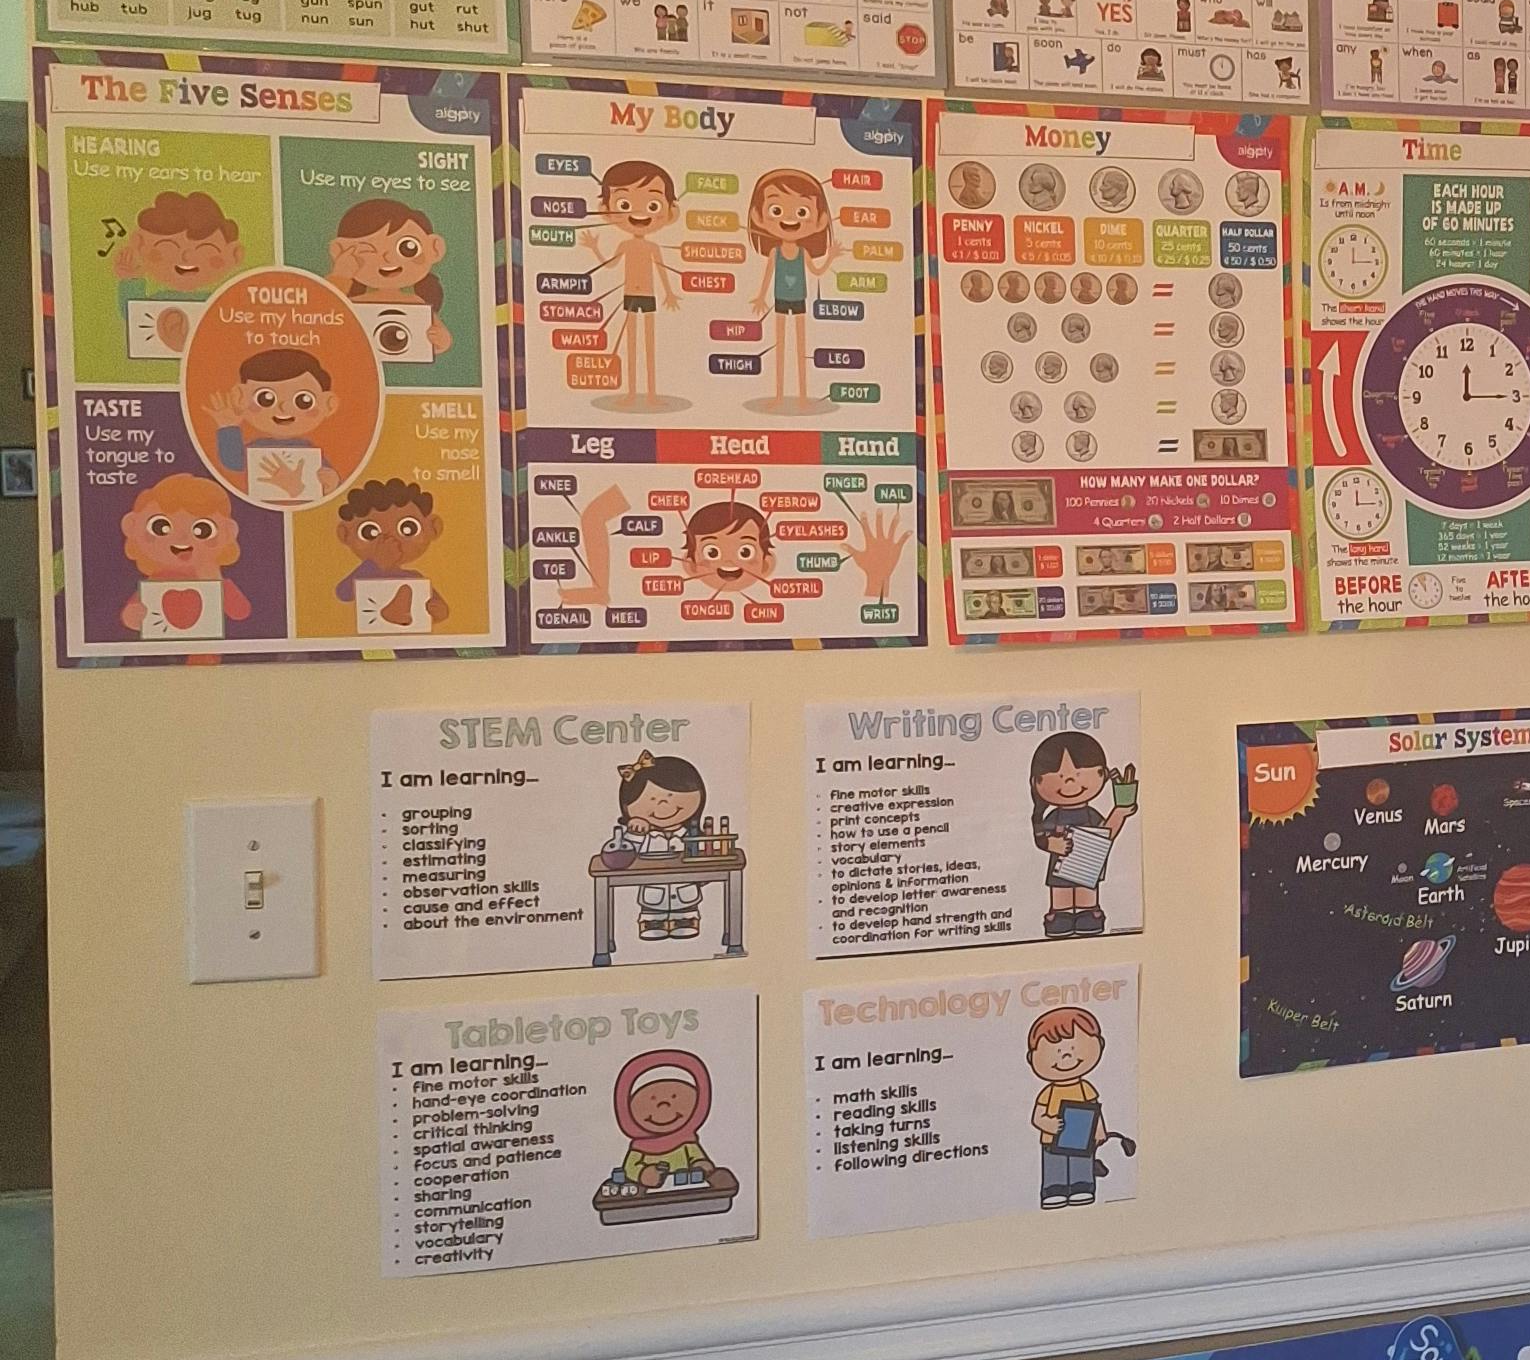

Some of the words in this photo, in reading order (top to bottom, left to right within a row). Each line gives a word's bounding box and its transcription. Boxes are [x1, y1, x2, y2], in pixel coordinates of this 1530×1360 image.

[81, 74, 147, 102] The
[159, 77, 229, 106] Five
[240, 83, 353, 112] Senses
[611, 102, 654, 133] My
[665, 105, 735, 137] Body
[72, 136, 160, 157] HEARING
[1025, 124, 1111, 156] Money
[1402, 138, 1462, 162] Time
[418, 151, 469, 170] SIGHT
[548, 158, 579, 171] EYES
[300, 170, 336, 188] Use
[339, 173, 367, 191] my
[371, 175, 411, 192] eyes
[417, 175, 436, 191] to
[440, 178, 471, 191] see
[952, 219, 993, 232] PENNY
[690, 275, 726, 290] CHEST
[247, 286, 307, 305] TOUCH
[84, 399, 142, 417] TASTE
[421, 402, 477, 420] SMELL
[572, 434, 615, 460] Leg
[710, 436, 770, 456] Head
[838, 436, 900, 456] Hand
[1080, 475, 1105, 488] HOW
[1111, 476, 1145, 488] MANY
[1150, 474, 1183, 487] MAKE
[1186, 474, 1208, 487] ONE
[1211, 474, 1259, 487] DOLLAR?
[1335, 575, 1402, 596] BEFORE
[439, 717, 542, 750] STEM
[554, 713, 689, 744] Center
[849, 709, 982, 741] Writing
[992, 704, 1109, 733] Center
[1389, 730, 1447, 753] Solar
[1254, 763, 1296, 784] Sun
[1354, 807, 1403, 827] Venus
[1424, 817, 1466, 836] Mars
[403, 838, 486, 851] classifying
[1296, 852, 1368, 874] Mercury
[403, 883, 498, 898] observation
[504, 881, 539, 893] skills
[1418, 886, 1465, 905] Earth
[819, 989, 1011, 1026] Technology
[1021, 978, 1128, 1007] Center
[1395, 993, 1453, 1012] Saturn
[445, 1014, 612, 1050] Tabletop
[621, 1008, 699, 1040] Toys
[413, 1093, 486, 1109] hand-eye
[491, 1084, 587, 1103] coordination
[834, 1153, 907, 1172] following
[912, 1144, 989, 1164] directions
